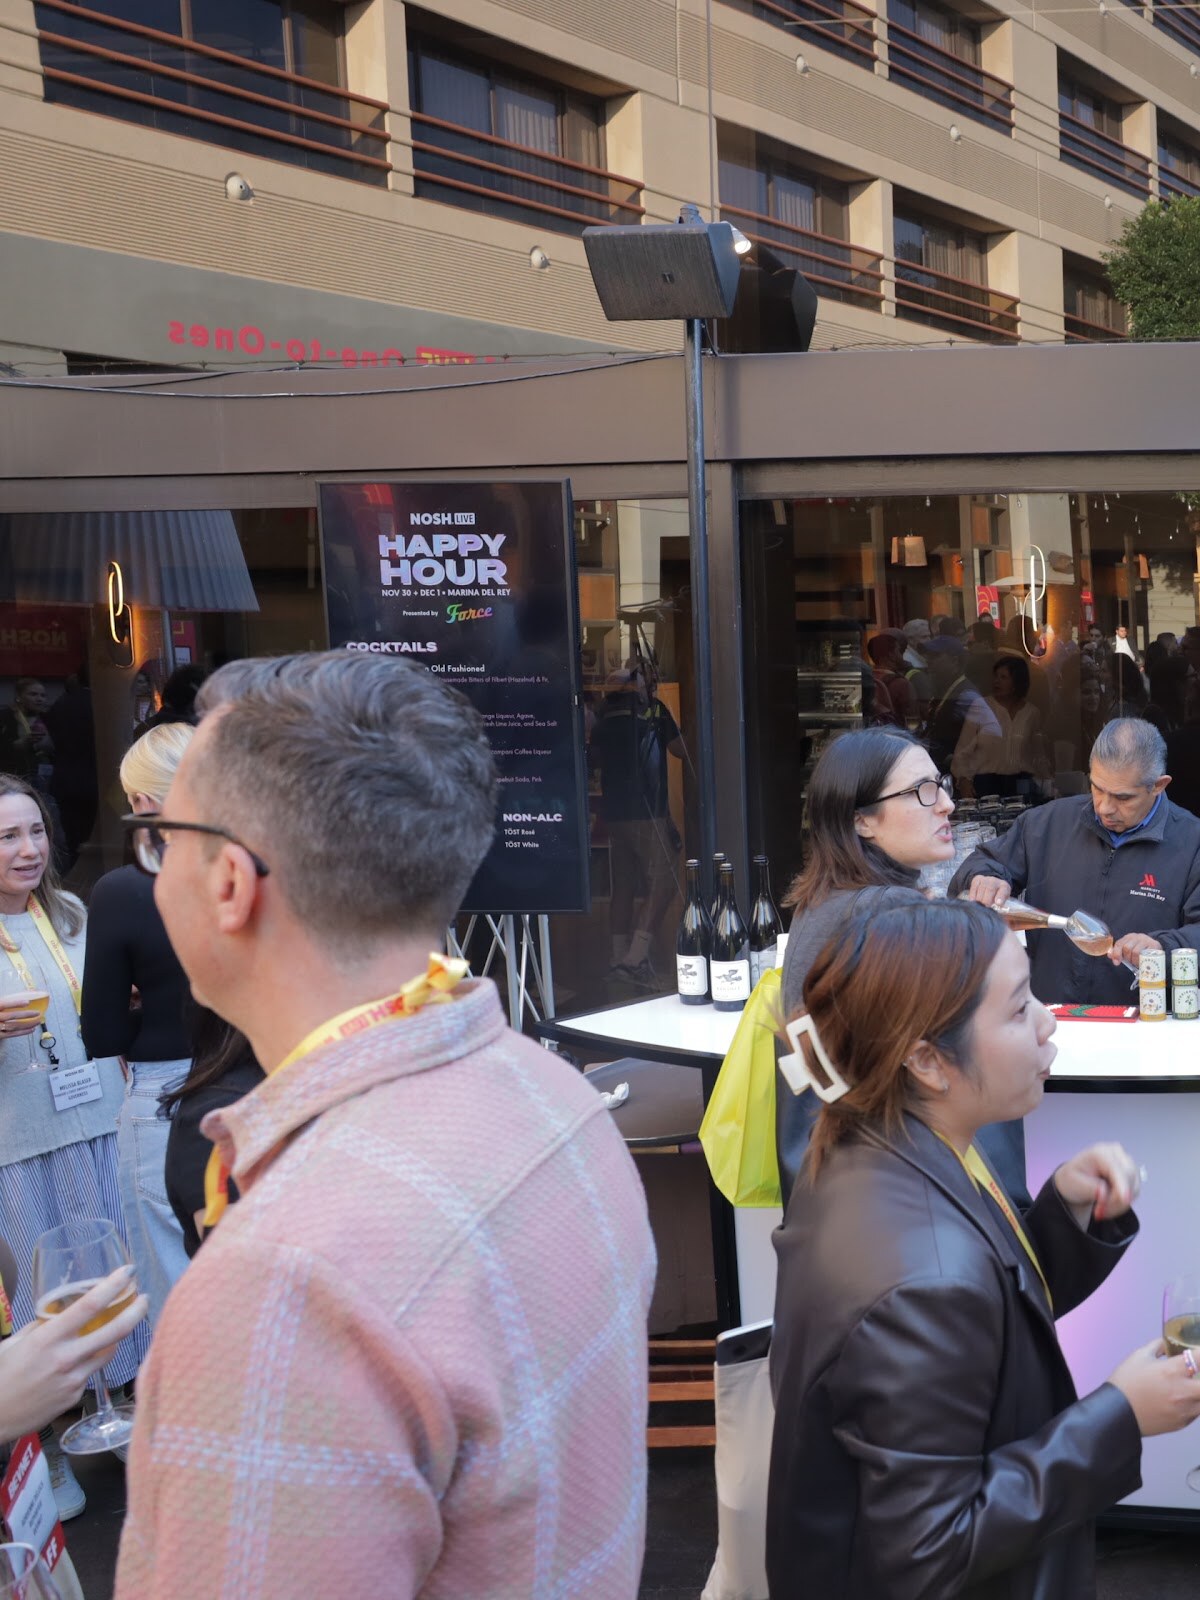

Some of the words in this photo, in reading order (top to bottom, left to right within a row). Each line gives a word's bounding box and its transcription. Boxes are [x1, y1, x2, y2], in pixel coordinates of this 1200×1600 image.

[410, 513, 451, 525] NOSH
[454, 512, 475, 525] LIVE
[378, 534, 506, 557] HAPPY
[380, 559, 508, 586] HOUR
[382, 589, 400, 597] NOV
[402, 588, 411, 597] 30
[420, 589, 435, 597] DEC
[447, 588, 480, 596] MARINA
[481, 588, 495, 596] DEL
[497, 588, 511, 596] REY
[431, 610, 439, 618] by
[445, 603, 493, 624] Force
[346, 641, 438, 653] COCKTAILS
[431, 664, 445, 673] Old
[447, 664, 485, 673] Fashioned
[485, 676, 491, 684] of
[491, 676, 507, 684] Filbert
[480, 713, 495, 721] ange
[516, 713, 535, 721] Agave,
[508, 720, 522, 728] Juice,
[514, 748, 532, 756] Coffee
[533, 748, 552, 756] Liqueur
[515, 776, 530, 784] Soda,
[503, 813, 563, 822] NON-ALC
[504, 827, 520, 836] TÖST
[521, 828, 535, 836] Rosé
[505, 841, 521, 849] TÖST
[1130, 889, 1147, 897] Marina
[1156, 894, 1166, 902] Rey
[8, 1441, 34, 1502] BEVNET
